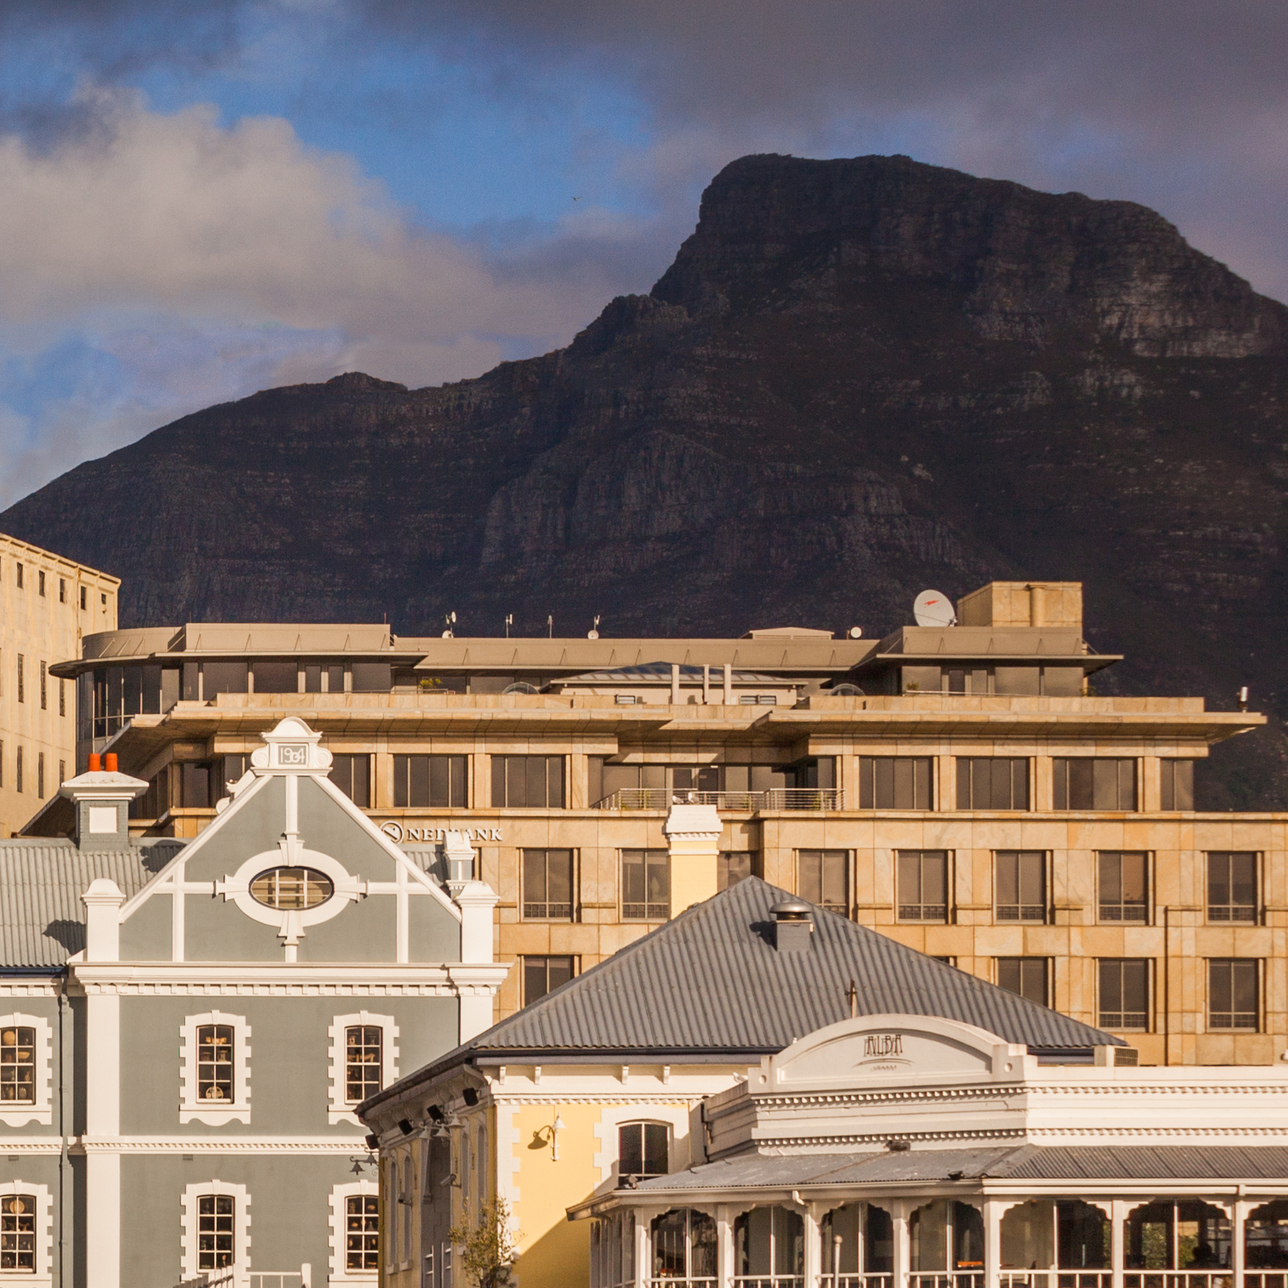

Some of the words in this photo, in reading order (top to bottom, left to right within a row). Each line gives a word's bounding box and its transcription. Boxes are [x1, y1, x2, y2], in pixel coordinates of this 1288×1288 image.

[280, 747, 305, 764] 1904
[407, 828, 503, 841] NEDANK
[864, 1034, 903, 1056] ALBA
